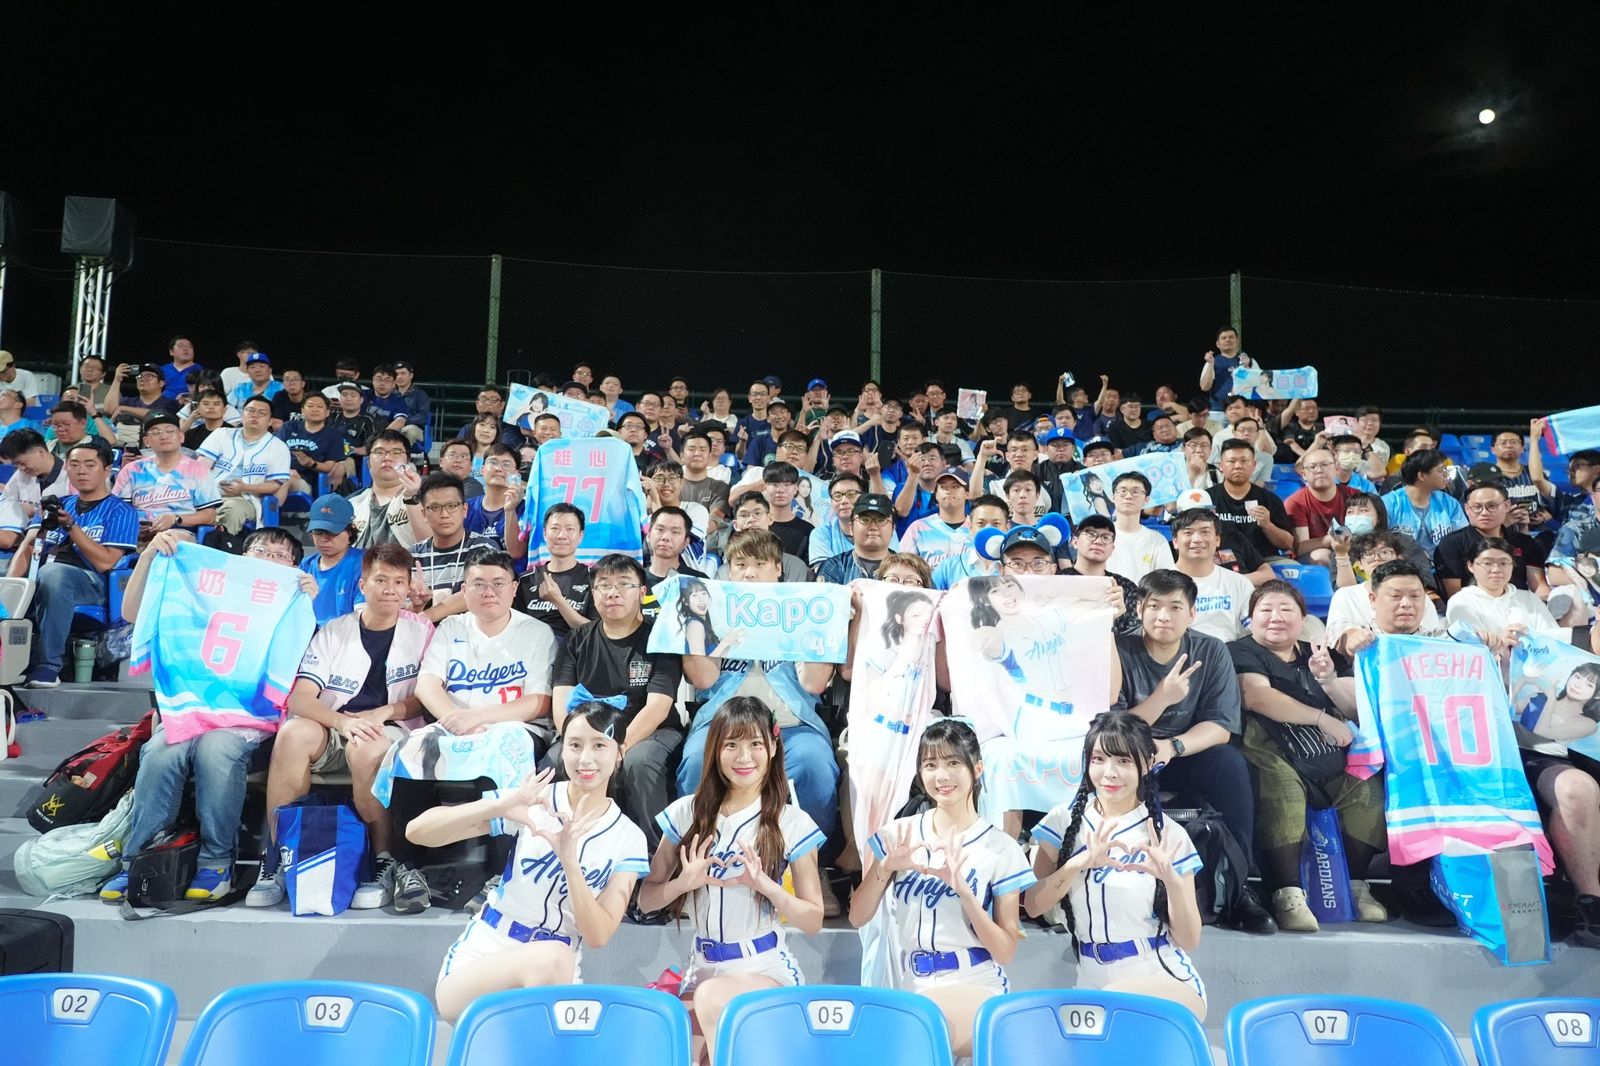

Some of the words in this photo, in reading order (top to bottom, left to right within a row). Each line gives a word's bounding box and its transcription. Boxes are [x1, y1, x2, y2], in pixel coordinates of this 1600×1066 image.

[552, 475, 606, 523] 77
[196, 568, 279, 605] 奶昔
[726, 593, 833, 633] Kapo
[201, 611, 250, 675] 6
[447, 659, 528, 694] Dodgers
[1402, 653, 1484, 681] KESHA
[1411, 695, 1494, 767] 10
[61, 995, 88, 1013] 02
[314, 1002, 341, 1021] 03
[565, 1006, 590, 1024] 04
[818, 1006, 844, 1024] 05
[1070, 1010, 1096, 1028] 06
[1314, 1016, 1338, 1034] 07
[1557, 1019, 1583, 1036] 08
